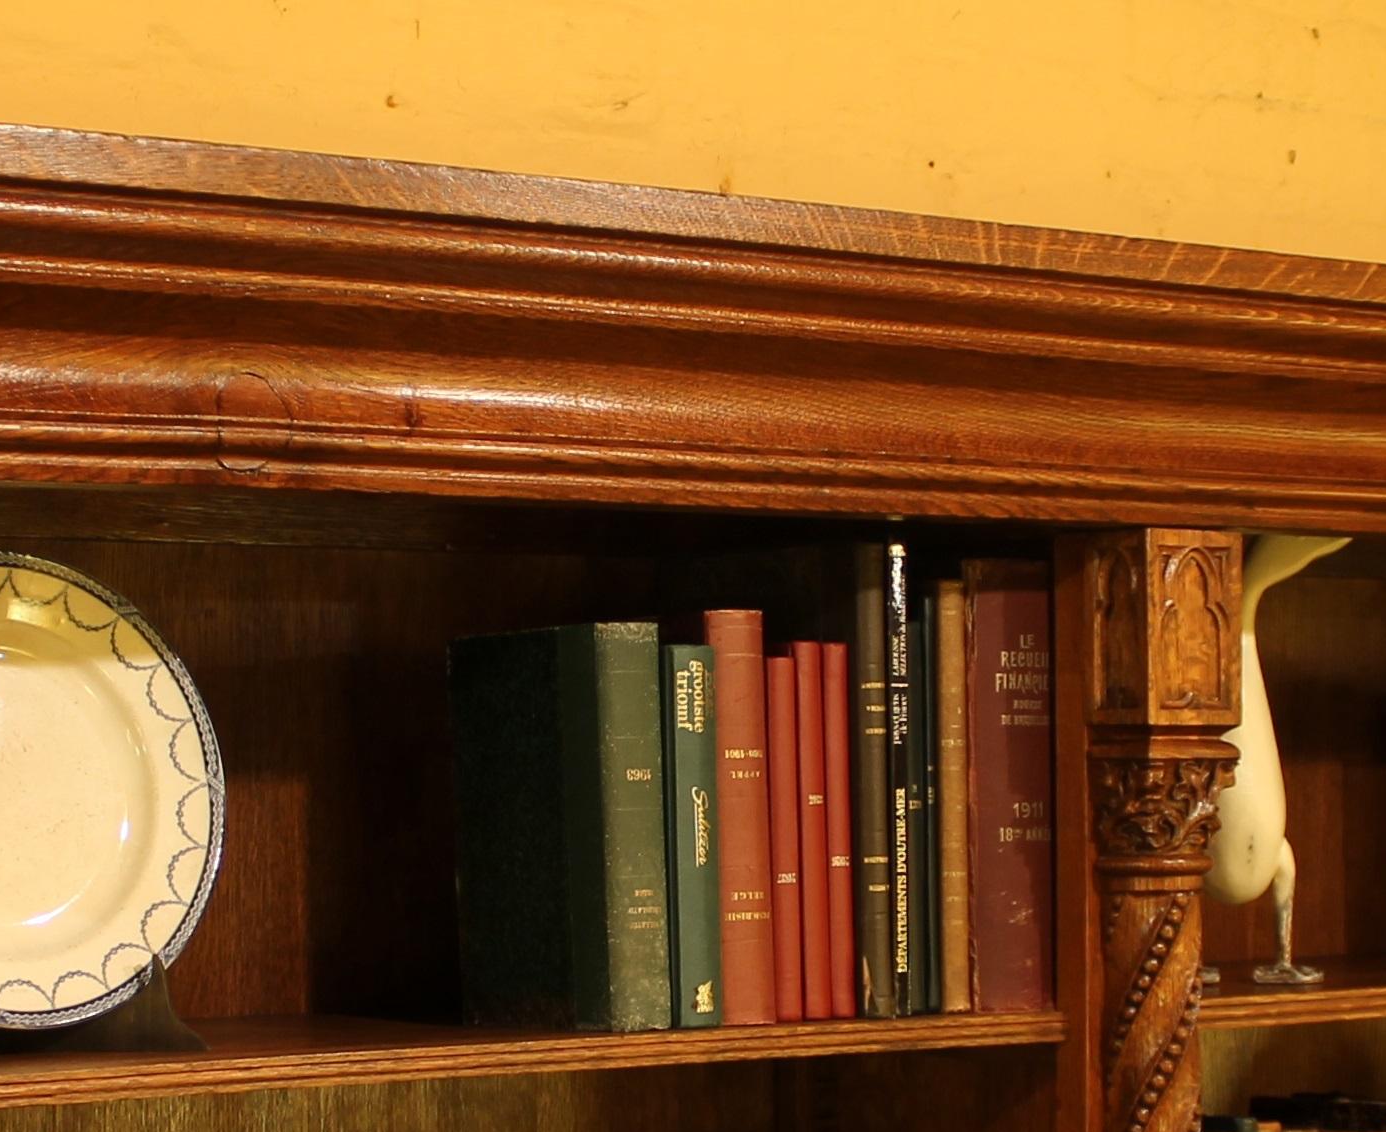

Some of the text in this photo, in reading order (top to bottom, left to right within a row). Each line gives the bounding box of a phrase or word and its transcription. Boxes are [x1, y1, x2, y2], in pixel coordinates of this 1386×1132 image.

[1020, 634, 1034, 649] LE
[677, 669, 692, 731] triomf
[689, 660, 705, 733] grootste
[626, 768, 652, 782] 1963
[692, 786, 711, 867] Sulitzer
[896, 788, 907, 873] D'OUTRE-MER
[1013, 801, 1043, 818] 1911
[896, 874, 908, 973] DÉPARTEMENTS
